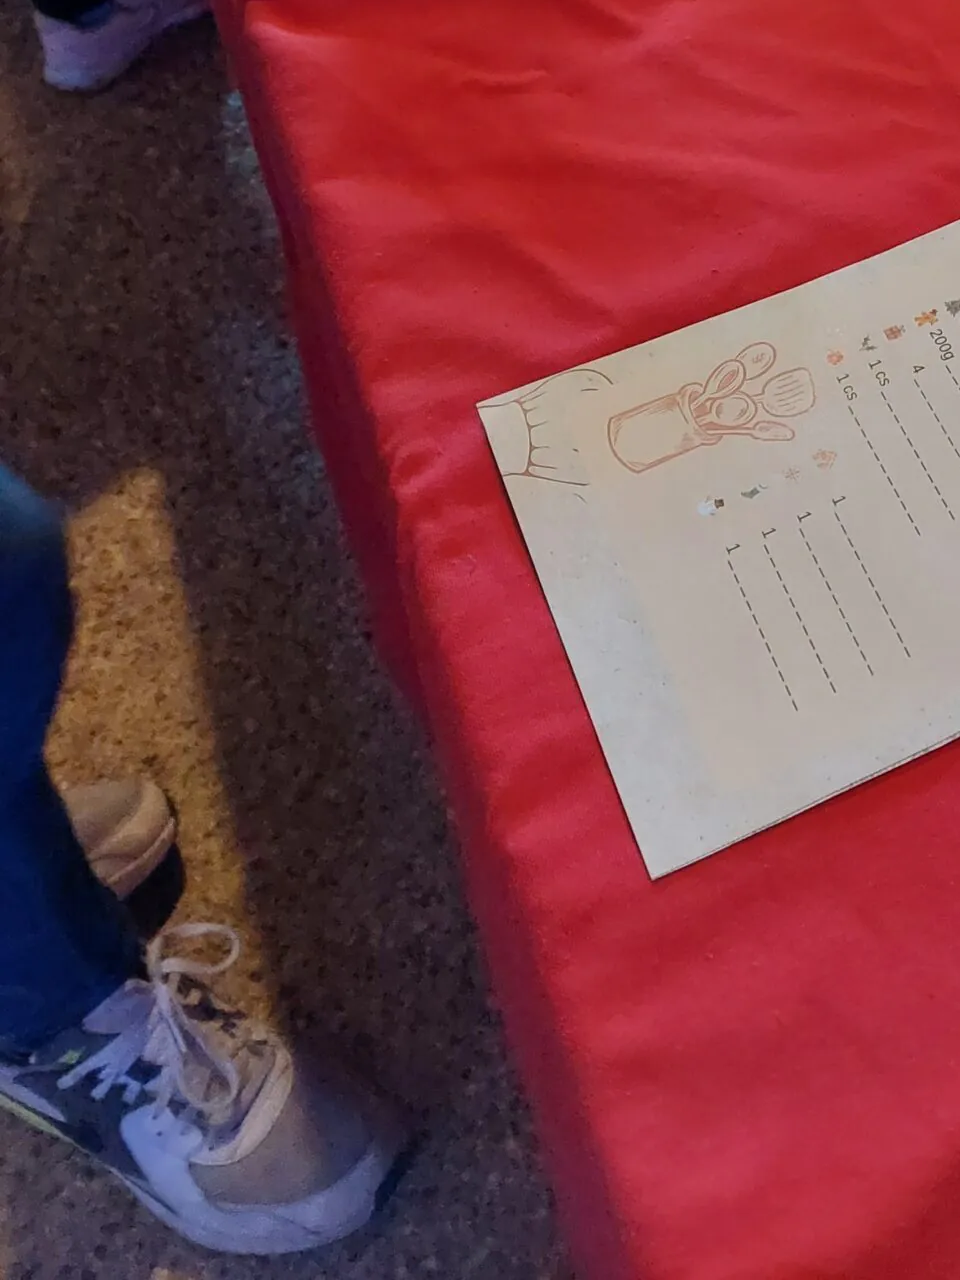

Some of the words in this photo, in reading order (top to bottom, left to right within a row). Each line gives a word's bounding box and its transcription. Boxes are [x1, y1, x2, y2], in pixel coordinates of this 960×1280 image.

[929, 328, 955, 361] 200g
[868, 359, 882, 370] 1
[875, 371, 890, 387] cs
[912, 365, 926, 374] 4
[836, 373, 850, 383] 1
[843, 385, 858, 401] cs
[832, 495, 846, 506] 1
[797, 511, 812, 522] 1
[761, 527, 776, 539] 1
[726, 543, 741, 554] 1
